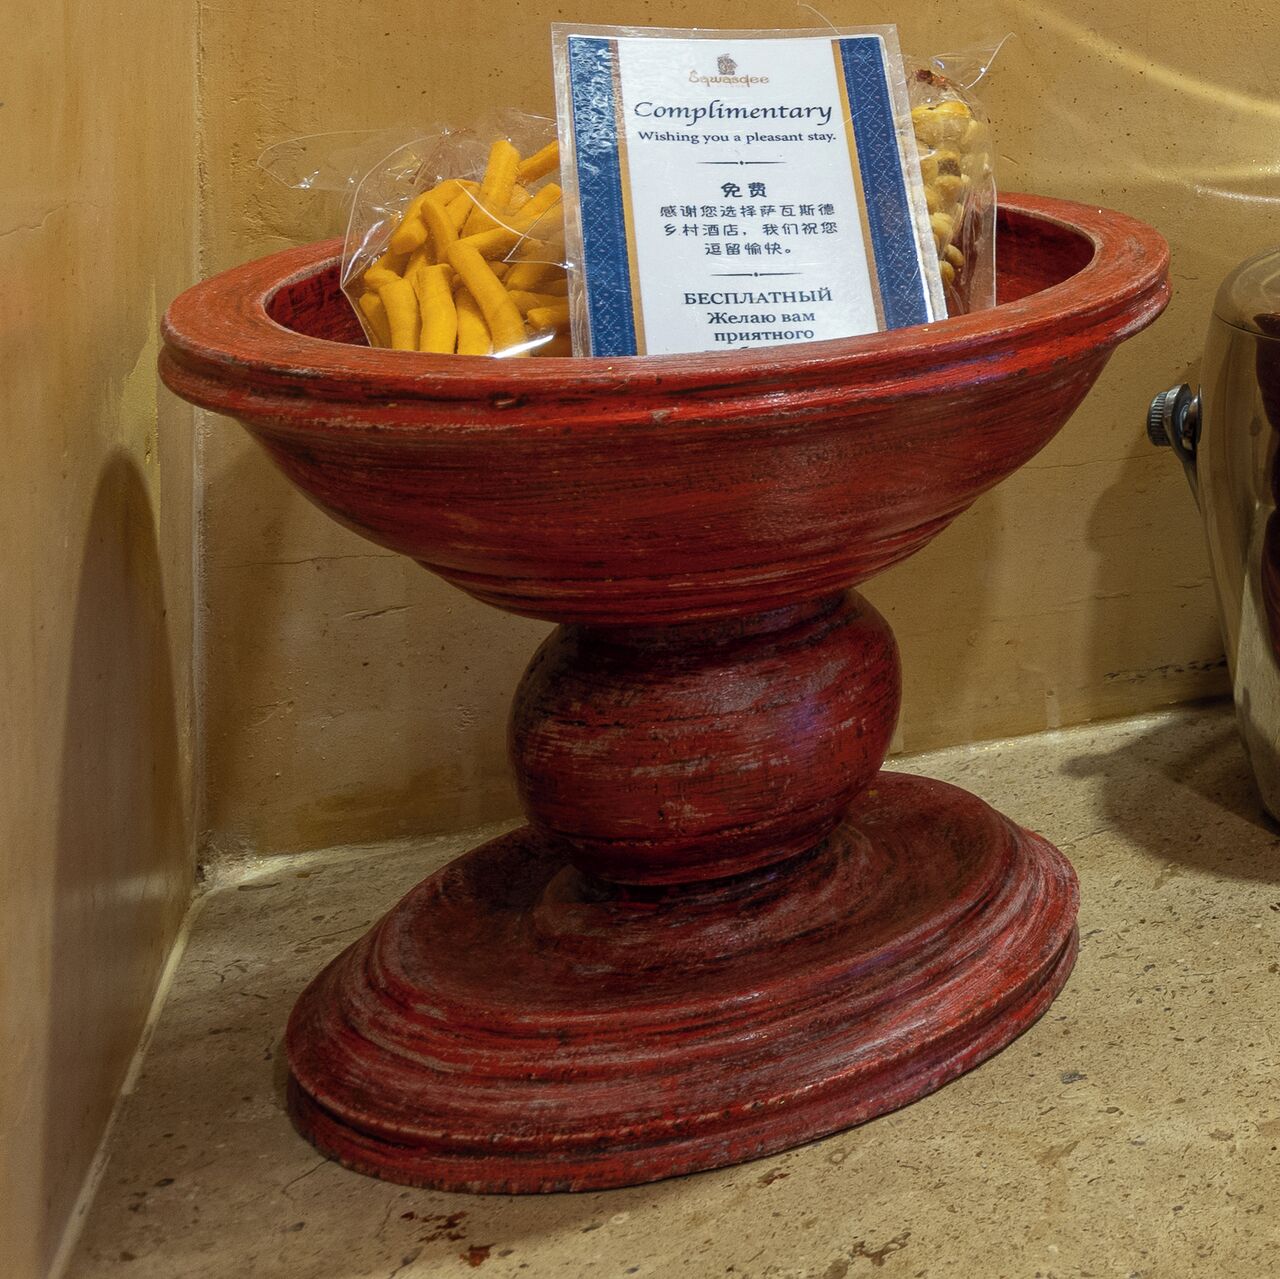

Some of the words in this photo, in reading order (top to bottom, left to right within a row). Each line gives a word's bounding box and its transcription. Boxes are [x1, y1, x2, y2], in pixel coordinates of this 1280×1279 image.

[634, 99, 832, 126] Complimentary
[638, 131, 700, 144] Wishing
[704, 133, 729, 145] you
[734, 134, 741, 142] a
[746, 131, 803, 145] pleasant
[808, 132, 836, 143] stay.
[721, 182, 768, 199] 免费
[660, 203, 836, 218] 感谢您选择萨瓦斯德
[705, 241, 791, 256] 逗留愉快。
[683, 287, 832, 305] БЕСПЛАТНЫЙ
[708, 312, 776, 324] Желаю
[781, 311, 815, 323] вам
[714, 329, 814, 344] приятного
